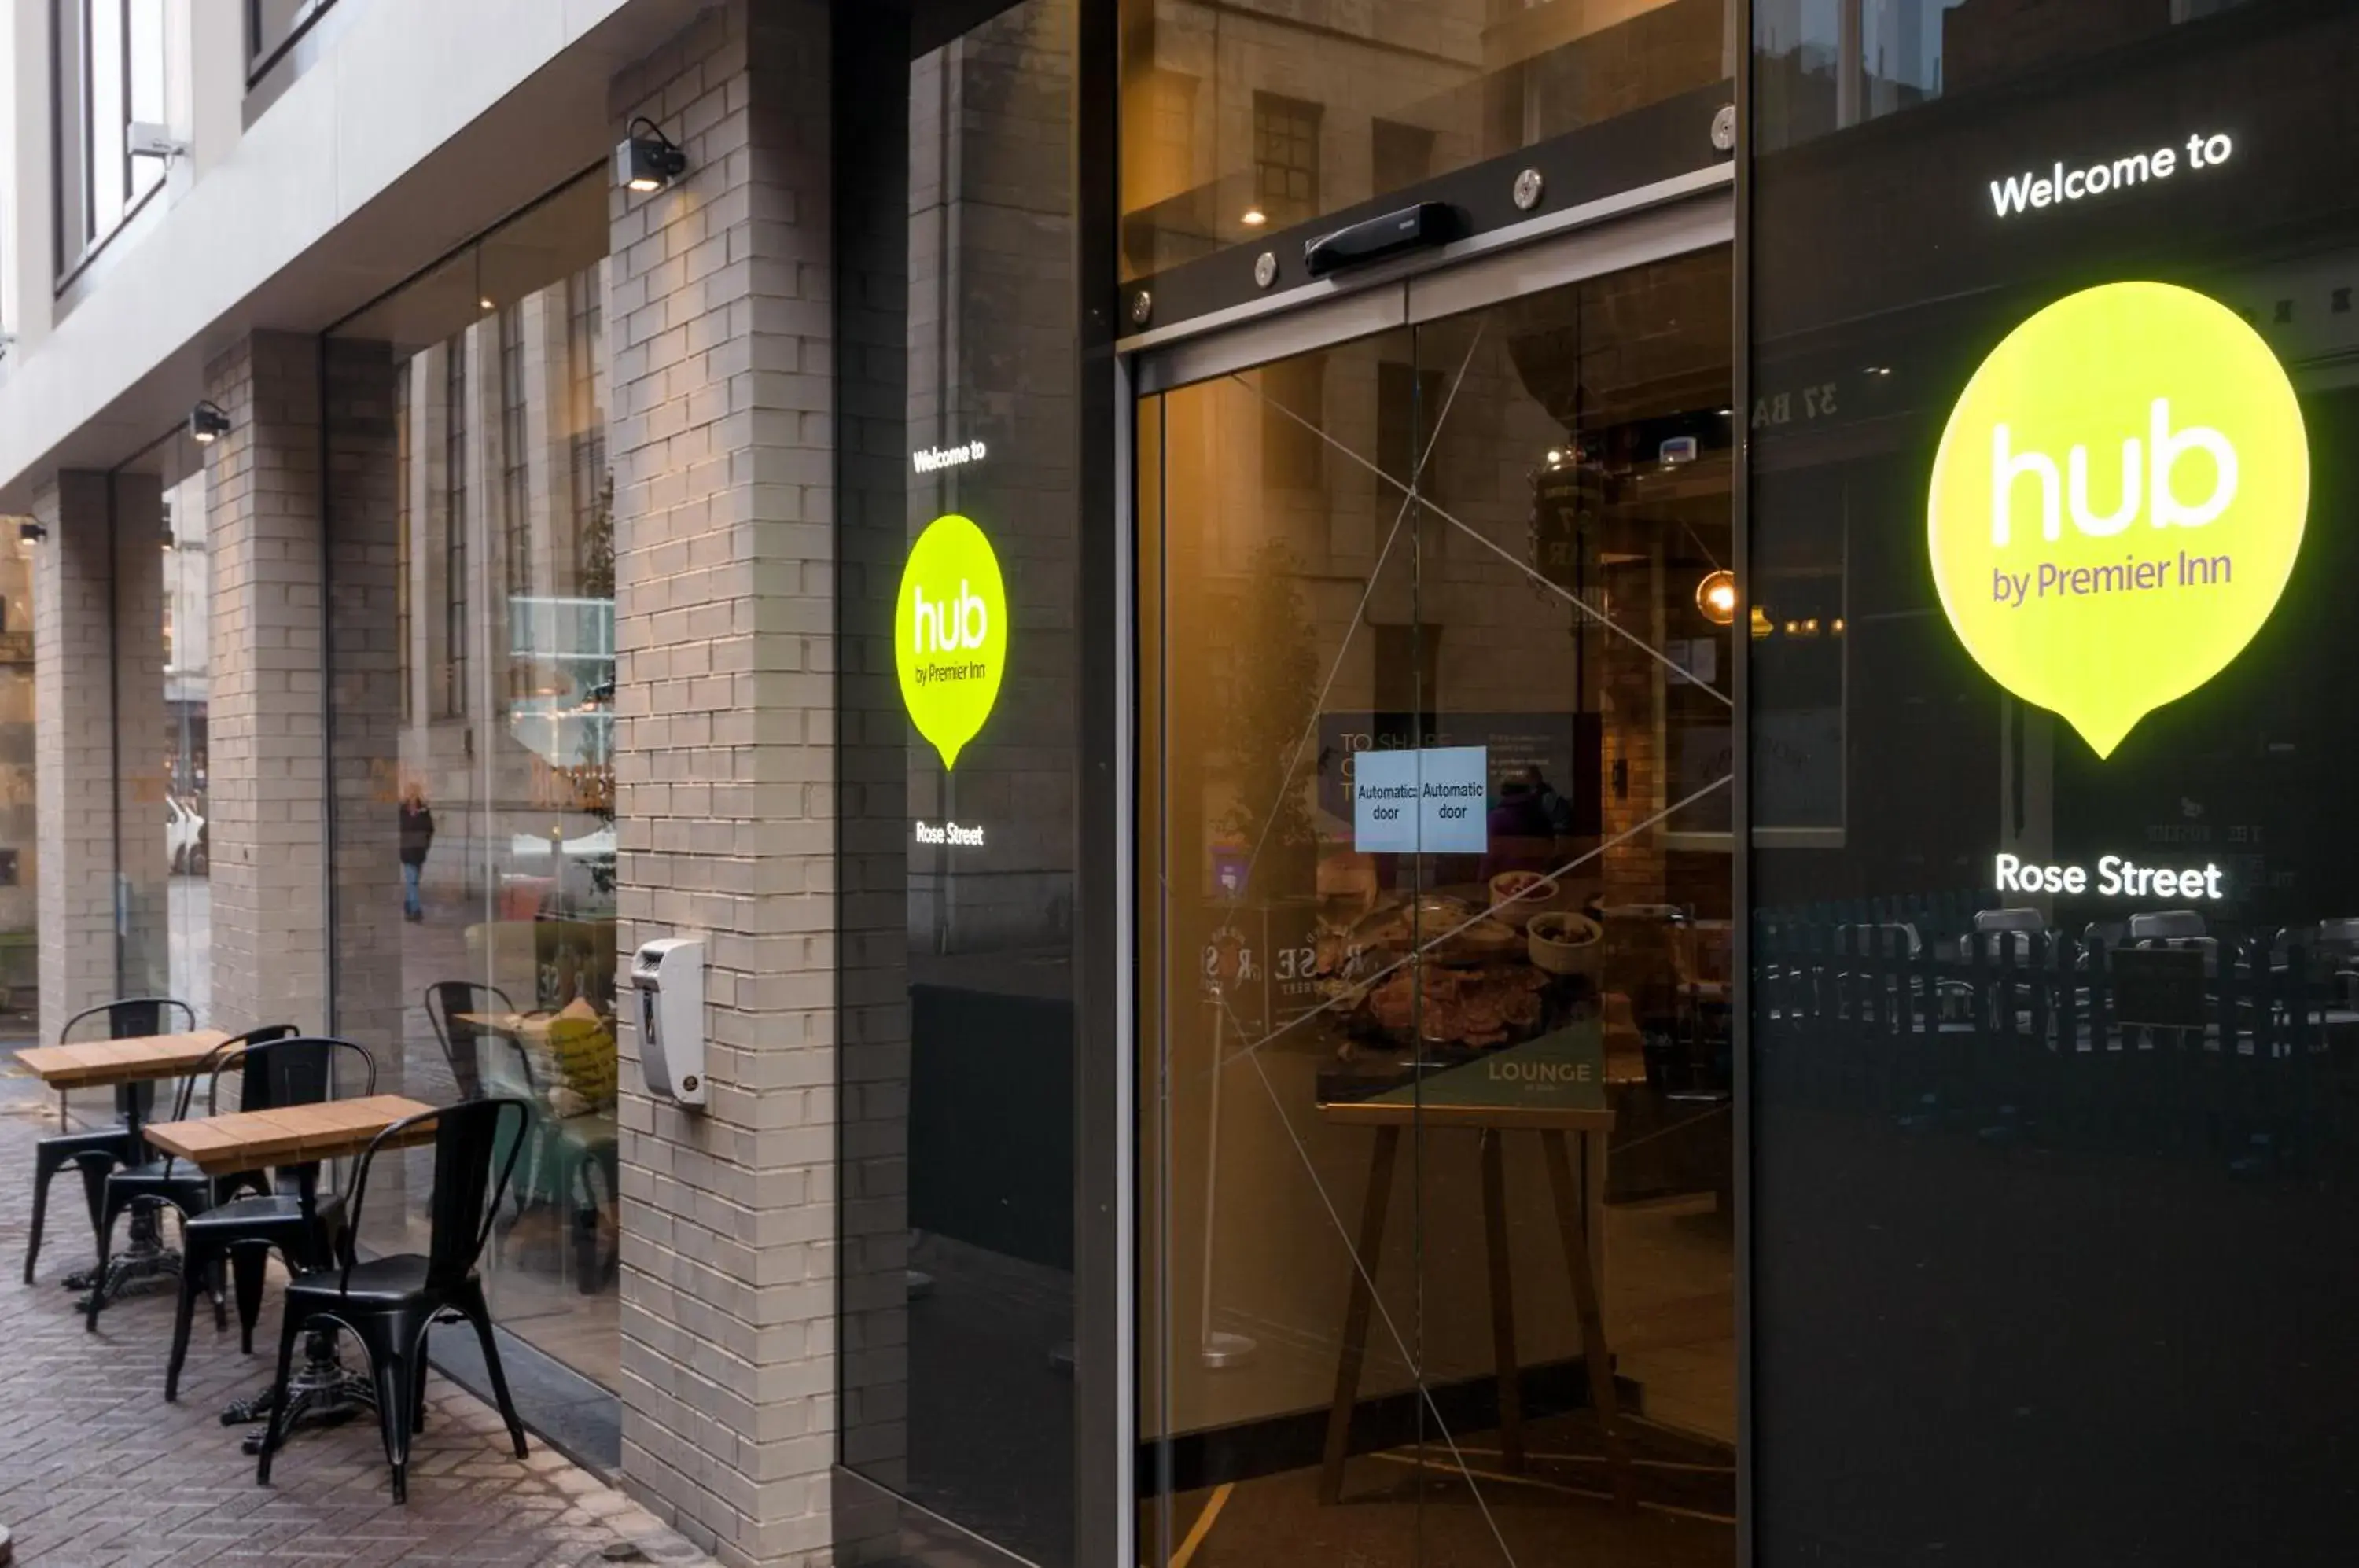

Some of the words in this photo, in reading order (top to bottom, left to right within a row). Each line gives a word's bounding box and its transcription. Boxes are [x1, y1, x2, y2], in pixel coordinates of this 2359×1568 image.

[1990, 147, 2176, 217] Welcome
[2186, 133, 2232, 169] to
[913, 445, 970, 473] Welcome
[970, 440, 985, 460] to
[1991, 396, 2239, 547] hub
[1993, 567, 2030, 608] by
[2037, 554, 2171, 598] Premier
[2179, 550, 2232, 587] Inn
[913, 577, 988, 654] hub
[915, 664, 928, 686] by
[929, 661, 968, 682] Premier
[970, 660, 986, 679] Inn
[1340, 734, 1372, 753] TO
[1358, 784, 1415, 800] Automatic
[1422, 782, 1485, 798] Automatic
[1372, 805, 1400, 819] door
[1438, 803, 1468, 819] door
[916, 821, 944, 844] Rose
[946, 822, 984, 846] Street
[1995, 853, 2086, 893] Rose
[2097, 855, 2223, 899] Street
[1488, 1061, 1592, 1083] LOUNGE
